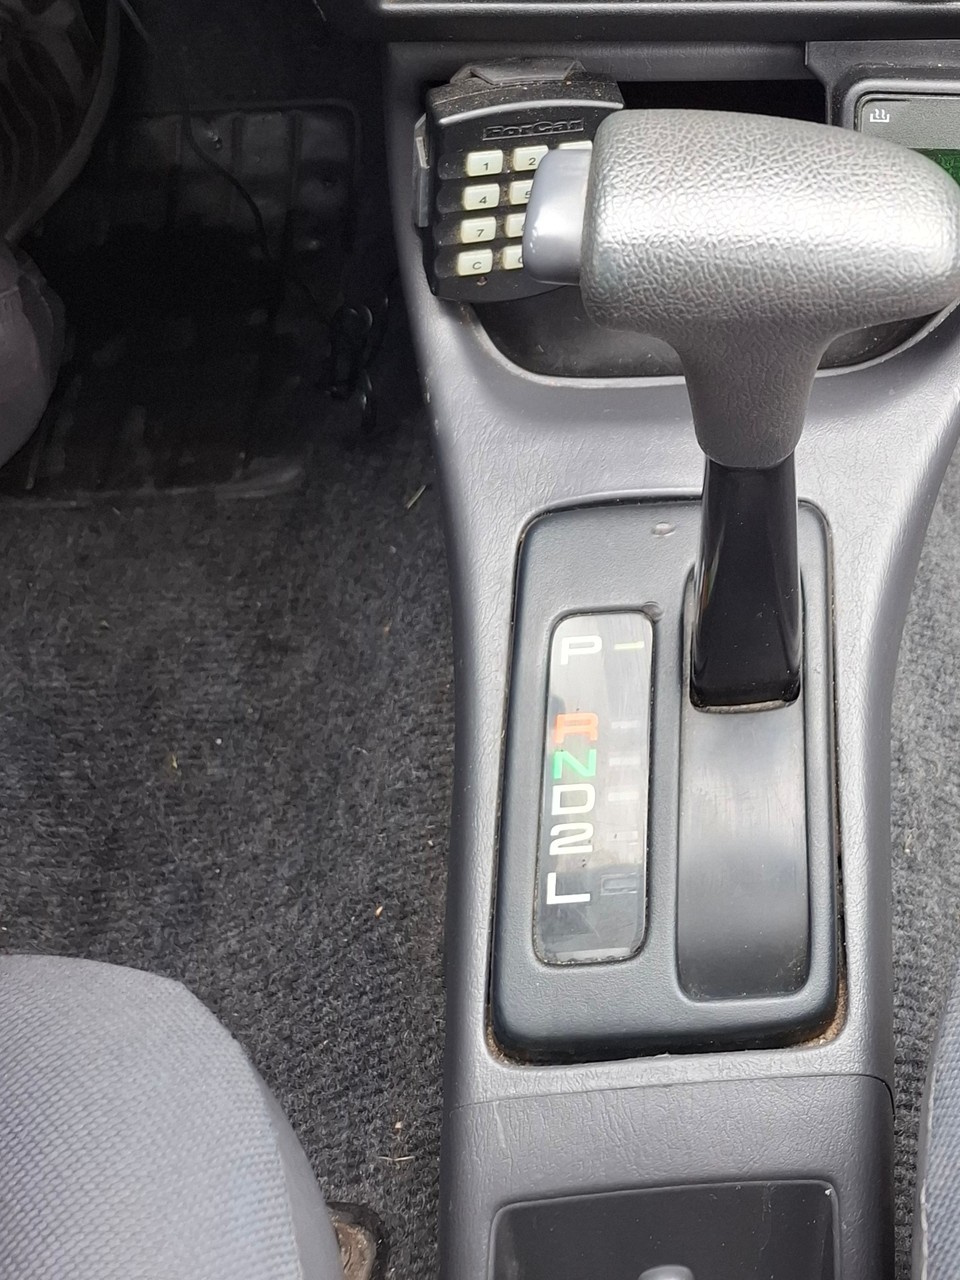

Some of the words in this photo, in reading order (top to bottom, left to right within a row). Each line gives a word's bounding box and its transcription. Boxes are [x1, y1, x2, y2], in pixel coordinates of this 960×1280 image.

[483, 162, 490, 171] 1
[528, 157, 537, 166] 2
[479, 195, 488, 205] 4
[476, 228, 485, 238] 7
[472, 261, 482, 270] C
[560, 635, 602, 665] P
[554, 712, 598, 744] R
[553, 749, 596, 779] N
[551, 783, 595, 816] D
[549, 822, 594, 856] 2
[546, 872, 591, 905] L
